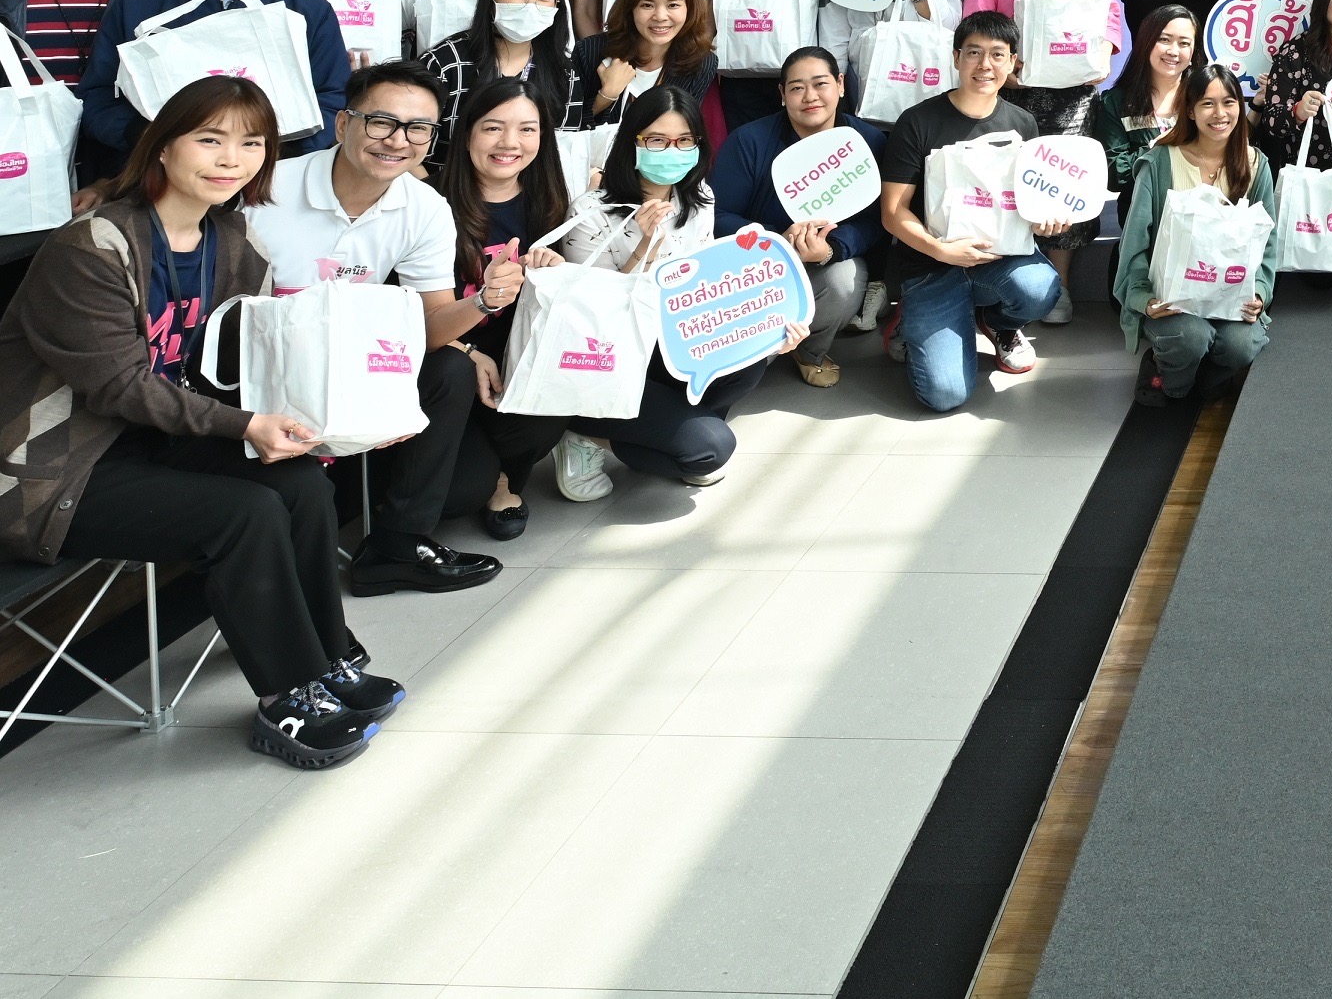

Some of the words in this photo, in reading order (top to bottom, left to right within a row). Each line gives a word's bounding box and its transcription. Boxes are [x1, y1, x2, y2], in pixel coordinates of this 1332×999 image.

[783, 140, 854, 200] Stronger
[1034, 143, 1088, 180] Never
[798, 157, 872, 216] Together
[1022, 169, 1060, 198] Give
[1063, 192, 1086, 213] up
[336, 264, 368, 278] มูลนิธิ
[664, 270, 682, 283] mtl
[667, 260, 785, 312] ขอส่งกำลังใจ
[678, 288, 785, 339] ให้ผู้ประสบภัย
[690, 314, 784, 359] ทุกคนปลอดภัย
